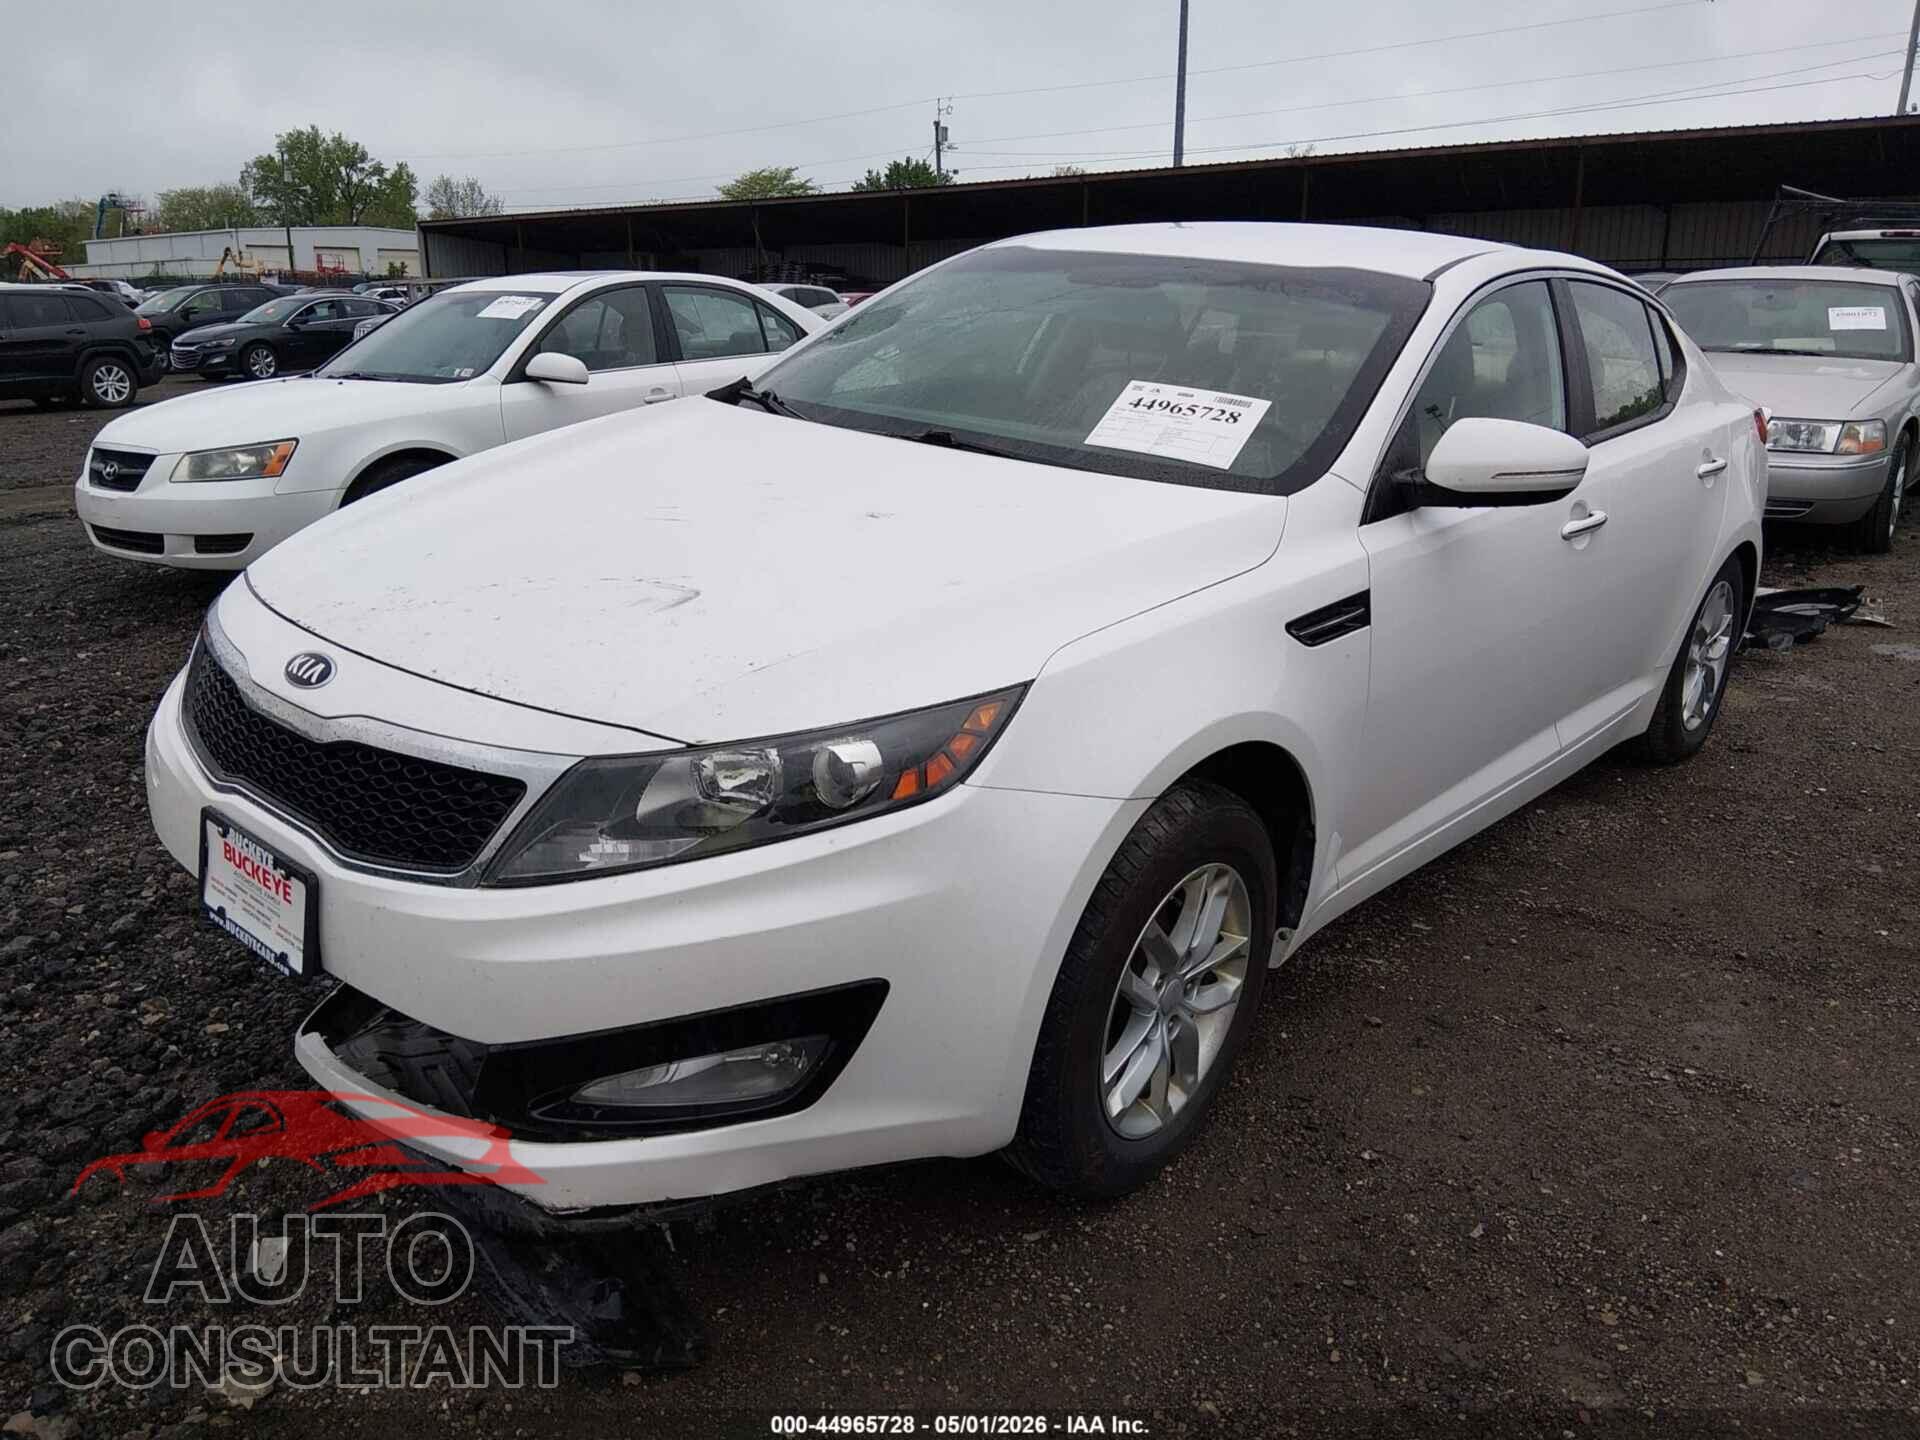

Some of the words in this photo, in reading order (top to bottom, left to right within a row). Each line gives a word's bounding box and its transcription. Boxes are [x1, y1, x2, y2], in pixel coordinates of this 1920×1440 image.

[1129, 396, 1242, 424] 44965728
[288, 654, 326, 684] KIA
[223, 841, 292, 905] BUCKEYE
